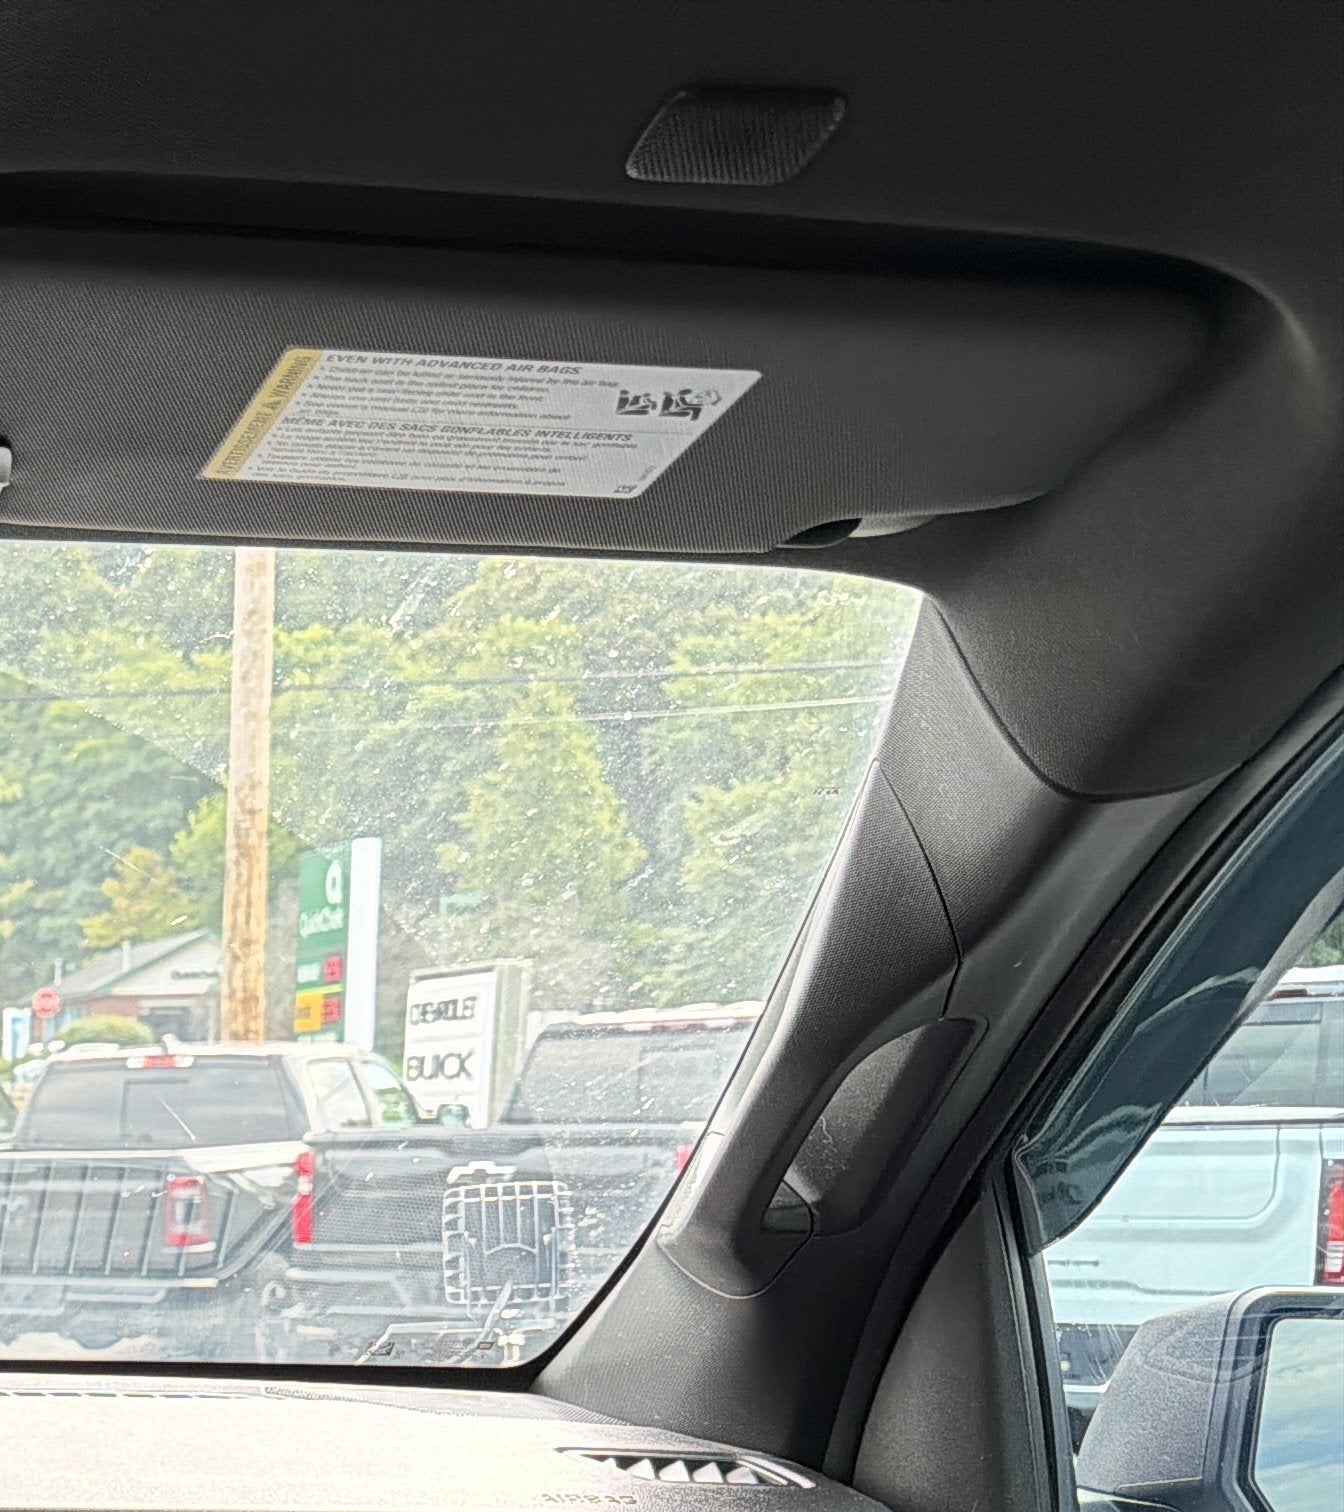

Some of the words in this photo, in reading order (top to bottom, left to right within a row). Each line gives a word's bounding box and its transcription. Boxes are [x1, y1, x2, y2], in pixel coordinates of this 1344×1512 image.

[271, 355, 312, 401] WARNING
[326, 355, 368, 365] EVEN
[372, 356, 413, 366] WITH
[414, 358, 504, 372] ADVANCED
[504, 363, 534, 373] AIR
[537, 364, 583, 375] BAGS
[328, 419, 365, 429] AVEC
[369, 421, 397, 431] DES
[399, 422, 437, 432] SACS
[440, 424, 533, 438] GONFLABLES
[534, 429, 633, 442] INTELLIGENTS
[406, 1049, 475, 1081] BUICK
